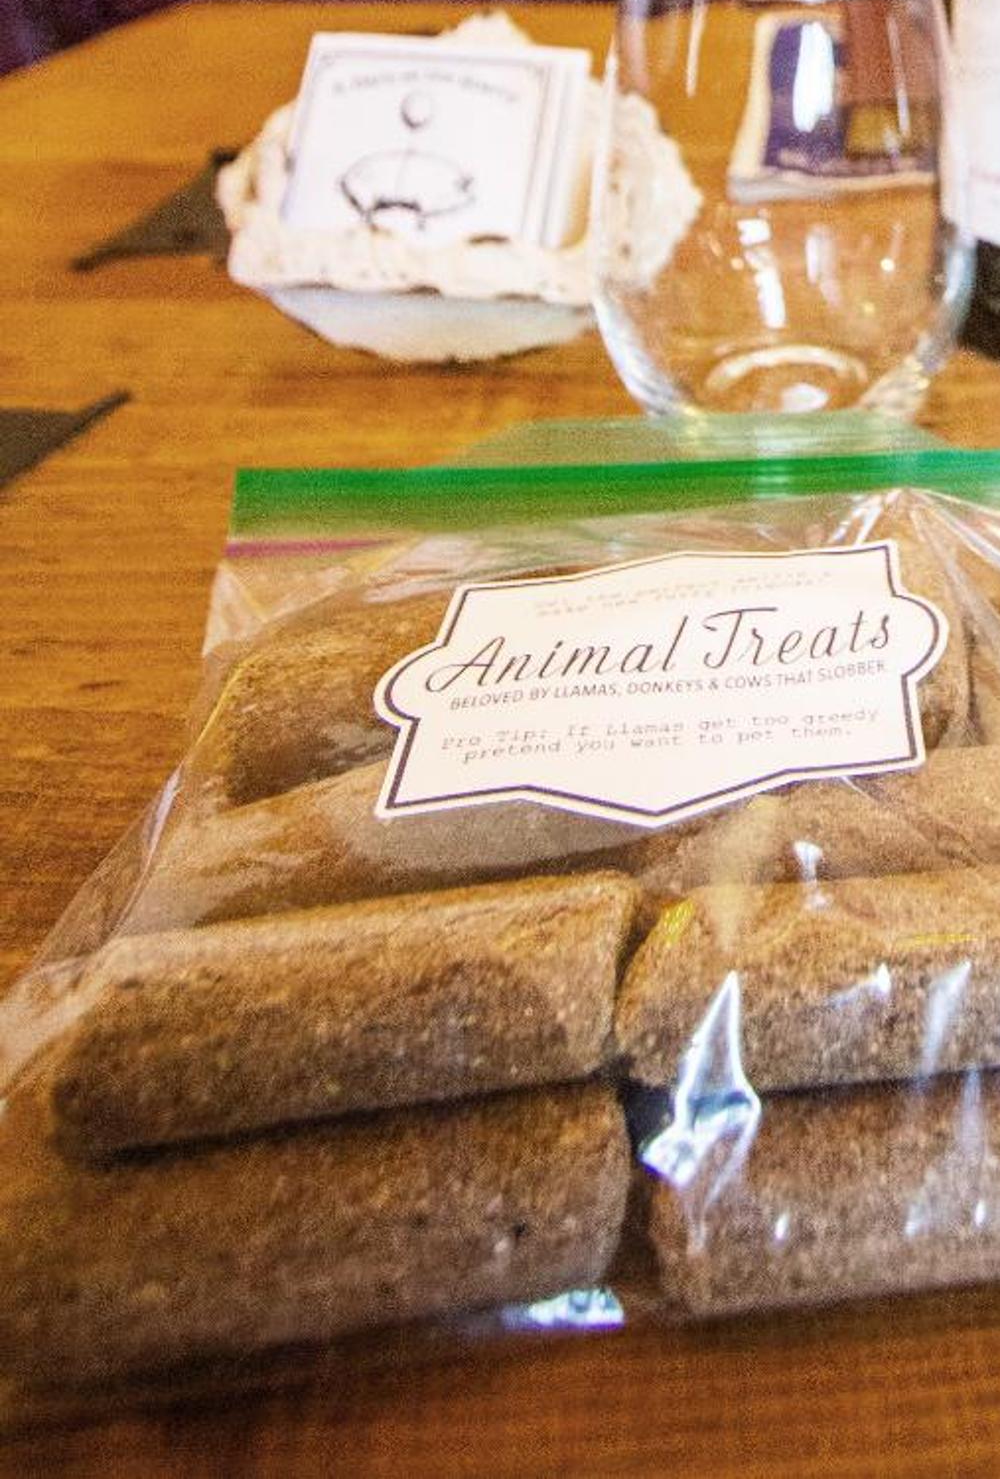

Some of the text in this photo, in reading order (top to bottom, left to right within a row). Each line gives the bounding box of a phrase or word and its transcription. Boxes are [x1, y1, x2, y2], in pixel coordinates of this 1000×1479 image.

[425, 606, 890, 693] Animal Treats
[449, 661, 886, 711] BELOVED BY LLAMAS, DONKEYS & COWS THAT SLOBBER
